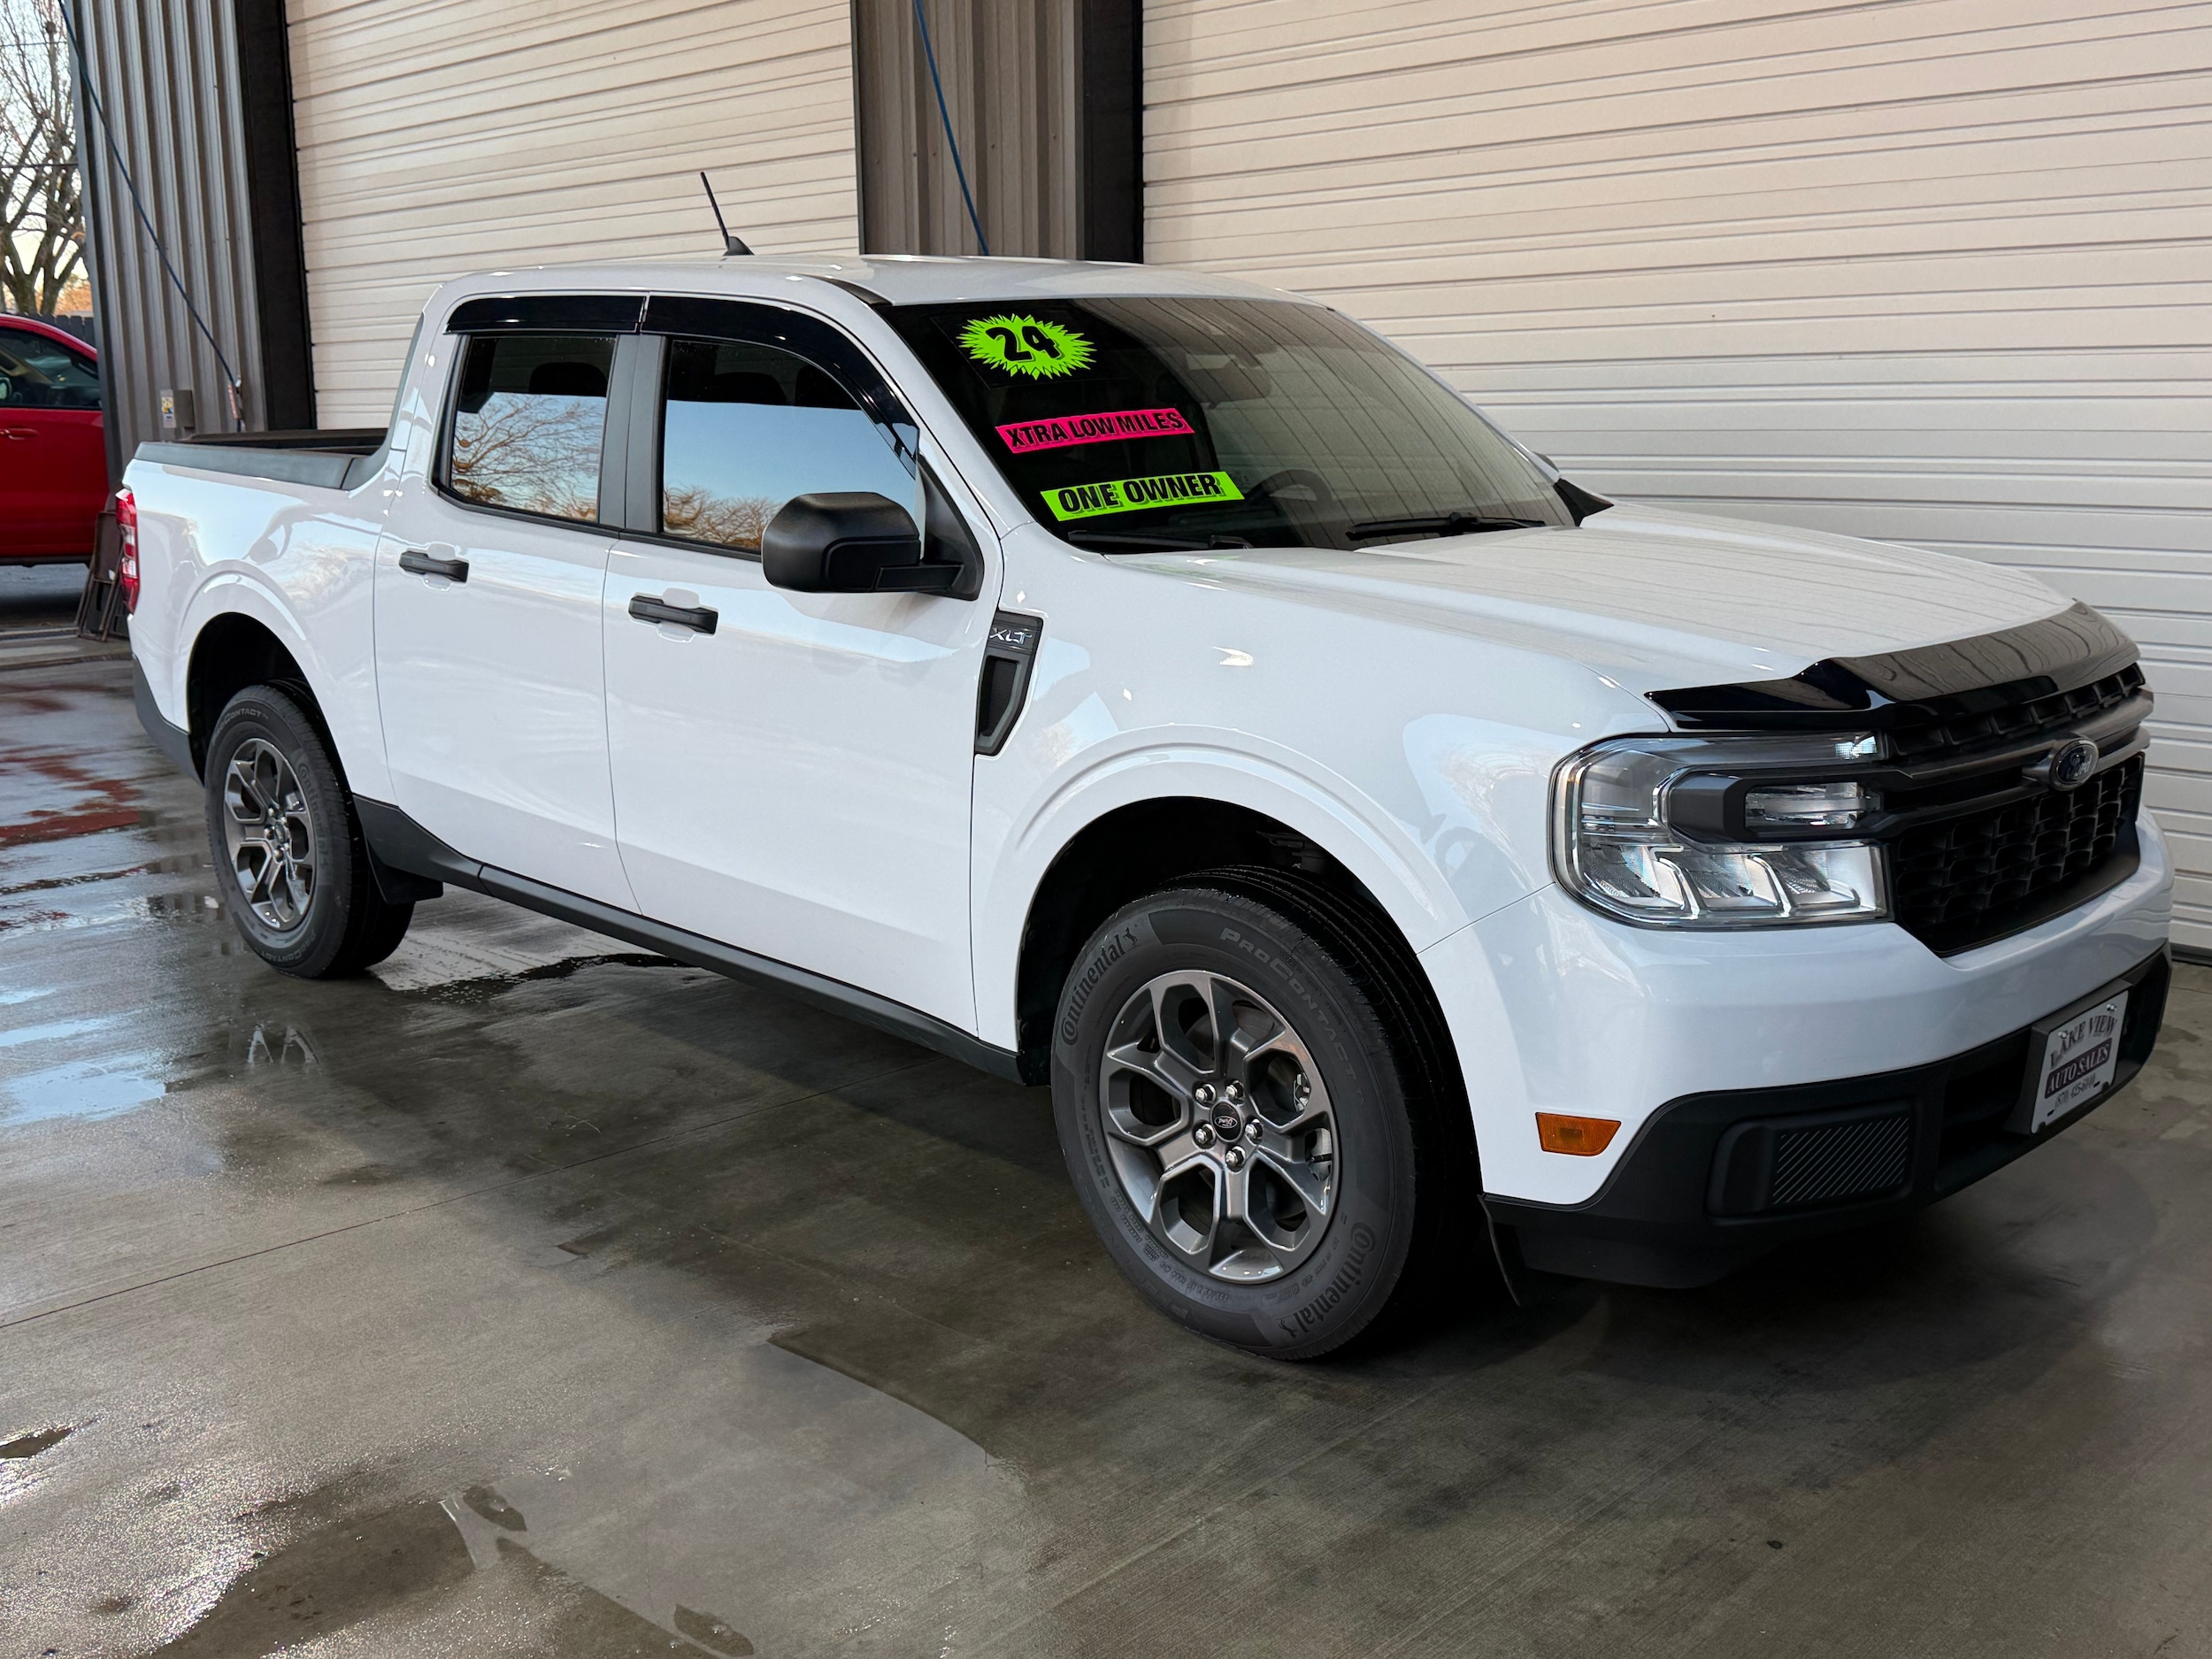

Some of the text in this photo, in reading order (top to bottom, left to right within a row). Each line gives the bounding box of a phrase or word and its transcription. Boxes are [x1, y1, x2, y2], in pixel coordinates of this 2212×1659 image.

[986, 326, 1062, 362] 24
[1005, 411, 1186, 449] XTRA LOW MILES
[1057, 473, 1224, 513] ONE OWNER
[989, 627, 1033, 644] XLT
[1061, 933, 1127, 1045] Continental
[2050, 1015, 2118, 1068] LAKE VIEW
[2047, 1043, 2109, 1094] AUTO SALES
[1292, 1222, 1377, 1333] Continental
